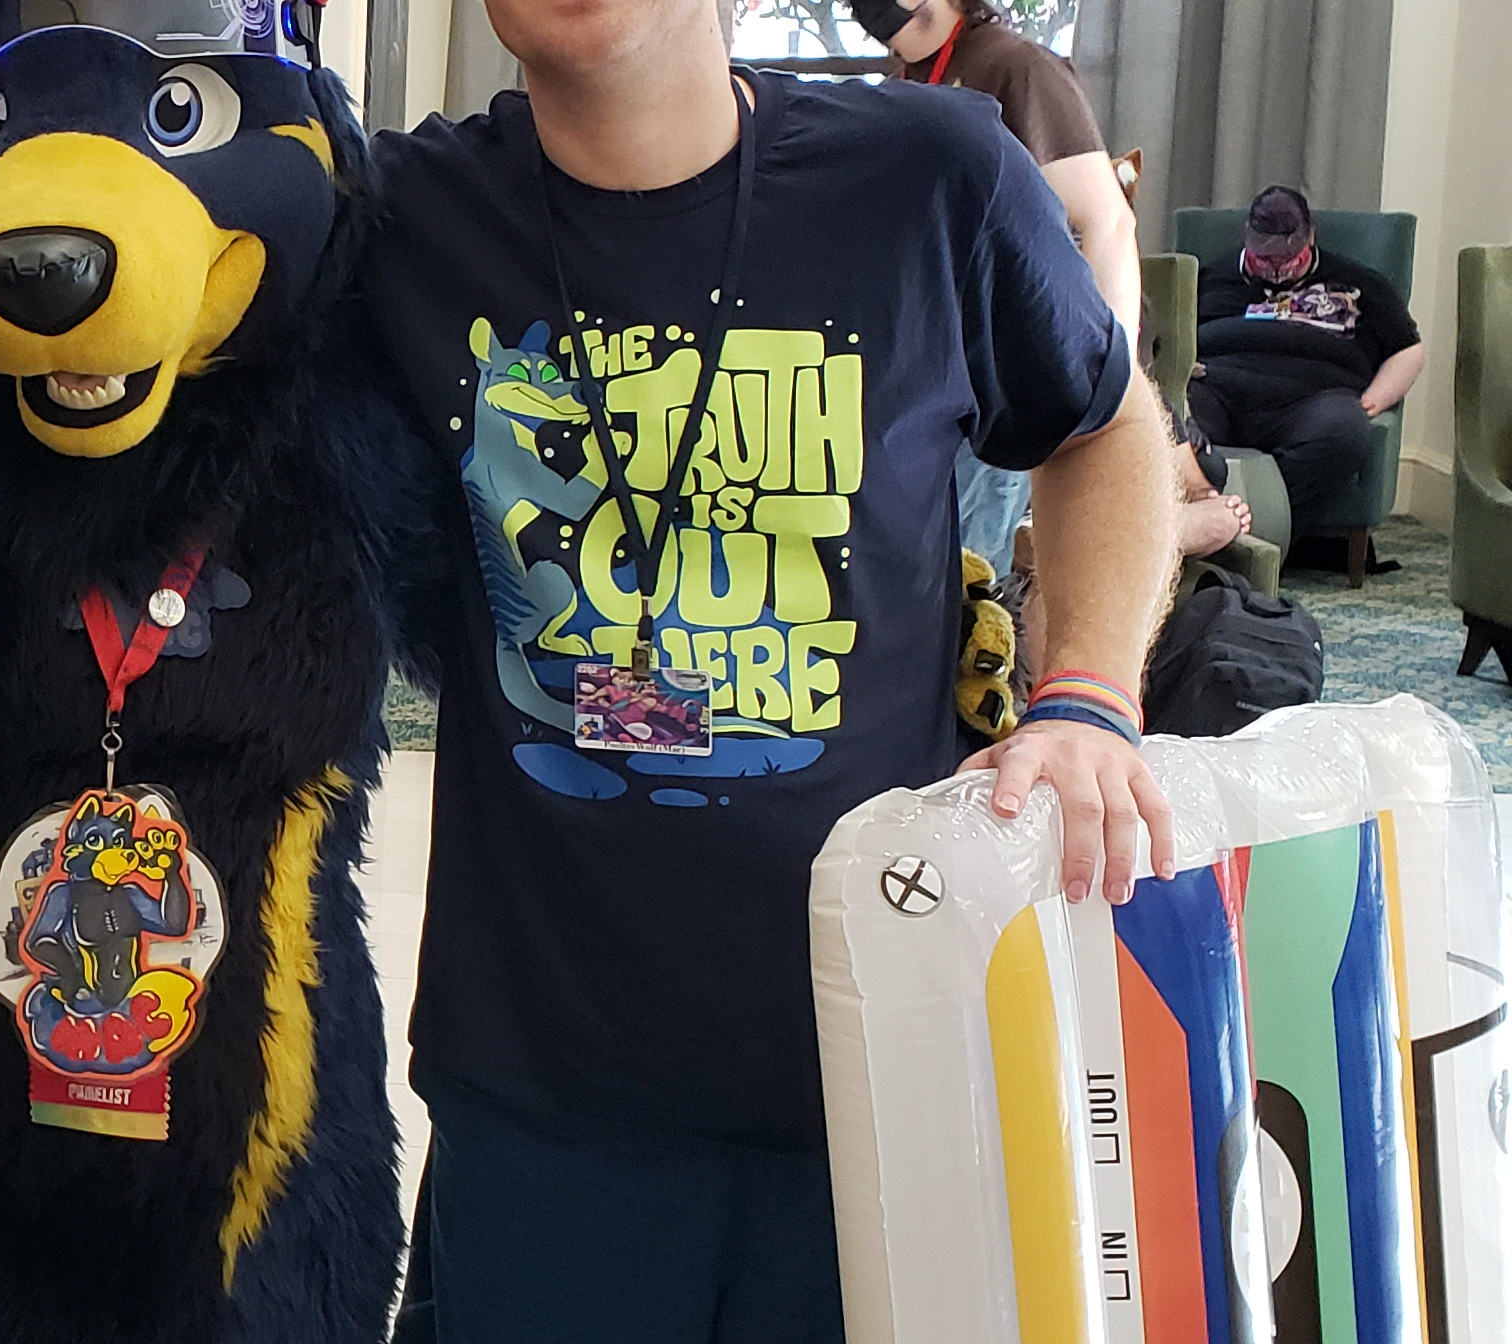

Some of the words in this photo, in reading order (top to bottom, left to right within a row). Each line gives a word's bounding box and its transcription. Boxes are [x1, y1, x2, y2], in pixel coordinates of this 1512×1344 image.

[558, 325, 655, 379] THE
[606, 328, 864, 494] TRUTH
[691, 486, 754, 532] IS
[580, 494, 851, 626] OUT
[68, 1082, 132, 1106] PANELIST
[1087, 1069, 1118, 1125] OUT
[1101, 1232, 1128, 1260] IN
